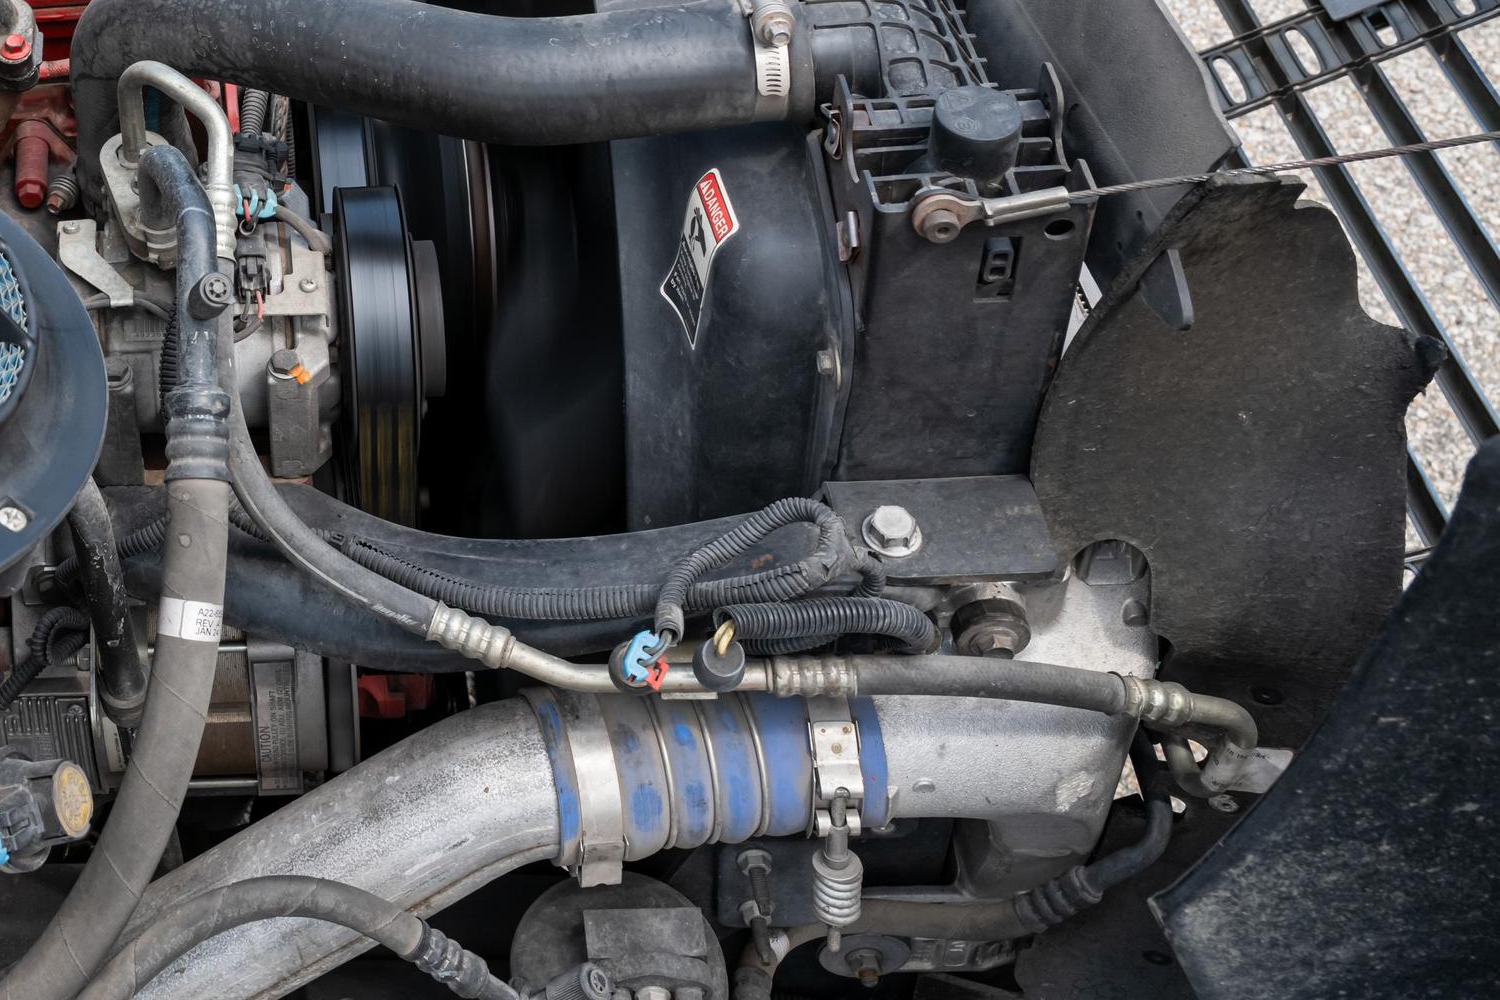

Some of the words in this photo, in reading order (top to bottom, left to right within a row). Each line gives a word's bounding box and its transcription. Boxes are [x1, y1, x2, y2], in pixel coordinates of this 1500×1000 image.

[703, 188, 729, 239] DANGER
[195, 627, 211, 636] JAN
[196, 618, 213, 628] REV
[259, 726, 271, 763] CAUTION
